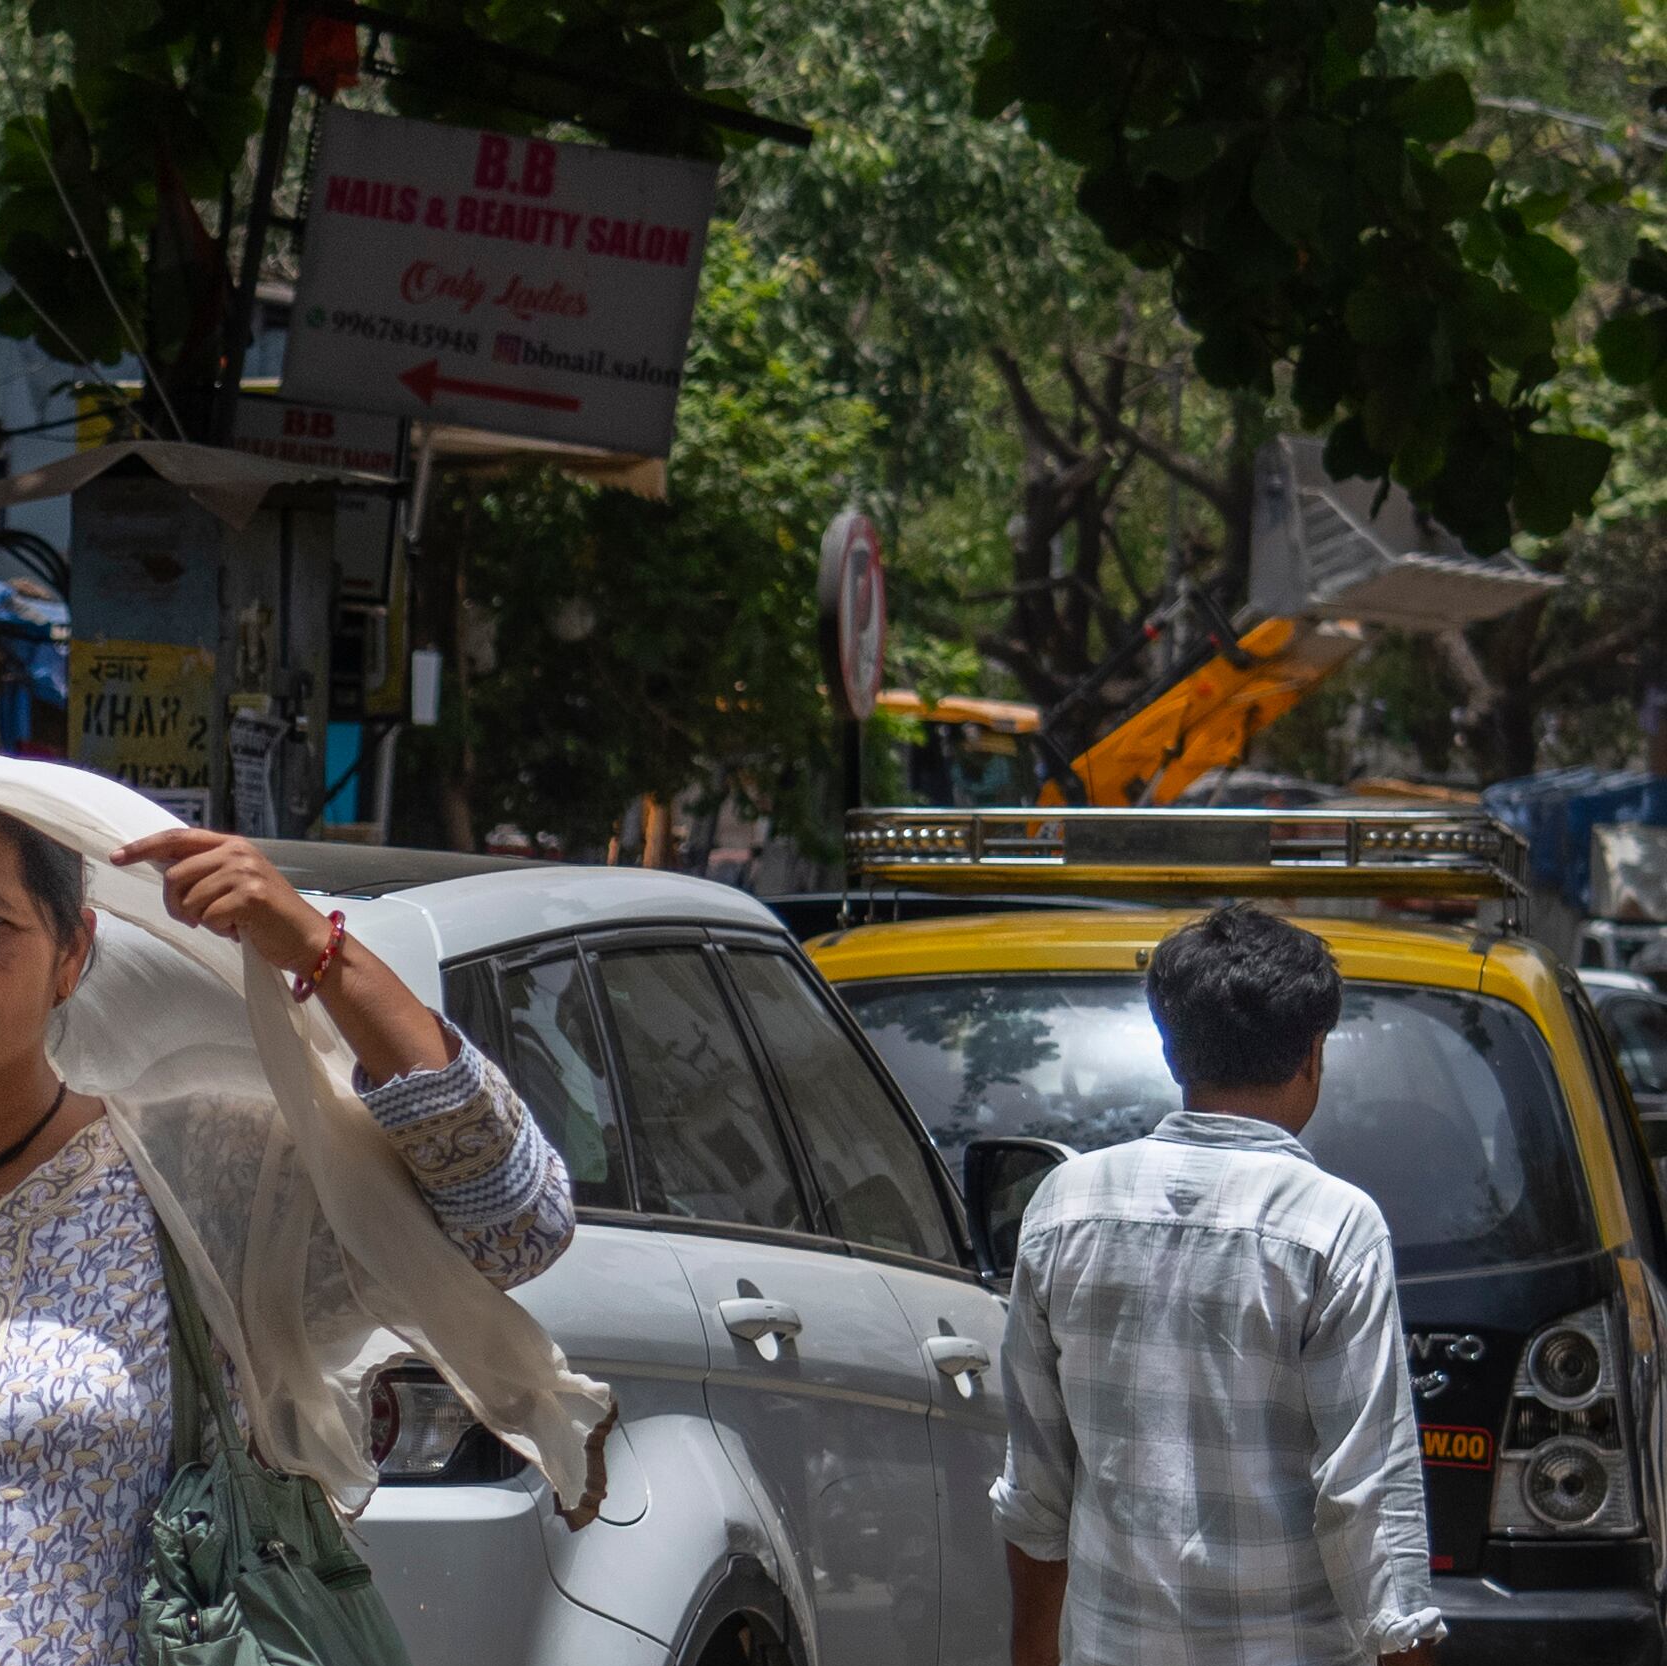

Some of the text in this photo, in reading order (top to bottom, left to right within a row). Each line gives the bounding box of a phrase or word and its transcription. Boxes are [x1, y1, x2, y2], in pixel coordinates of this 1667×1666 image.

[474, 130, 557, 197] B.B
[327, 176, 691, 267] NAILS & BEAUTY SALON
[399, 259, 487, 315] Only
[82, 692, 181, 738] KHAR
